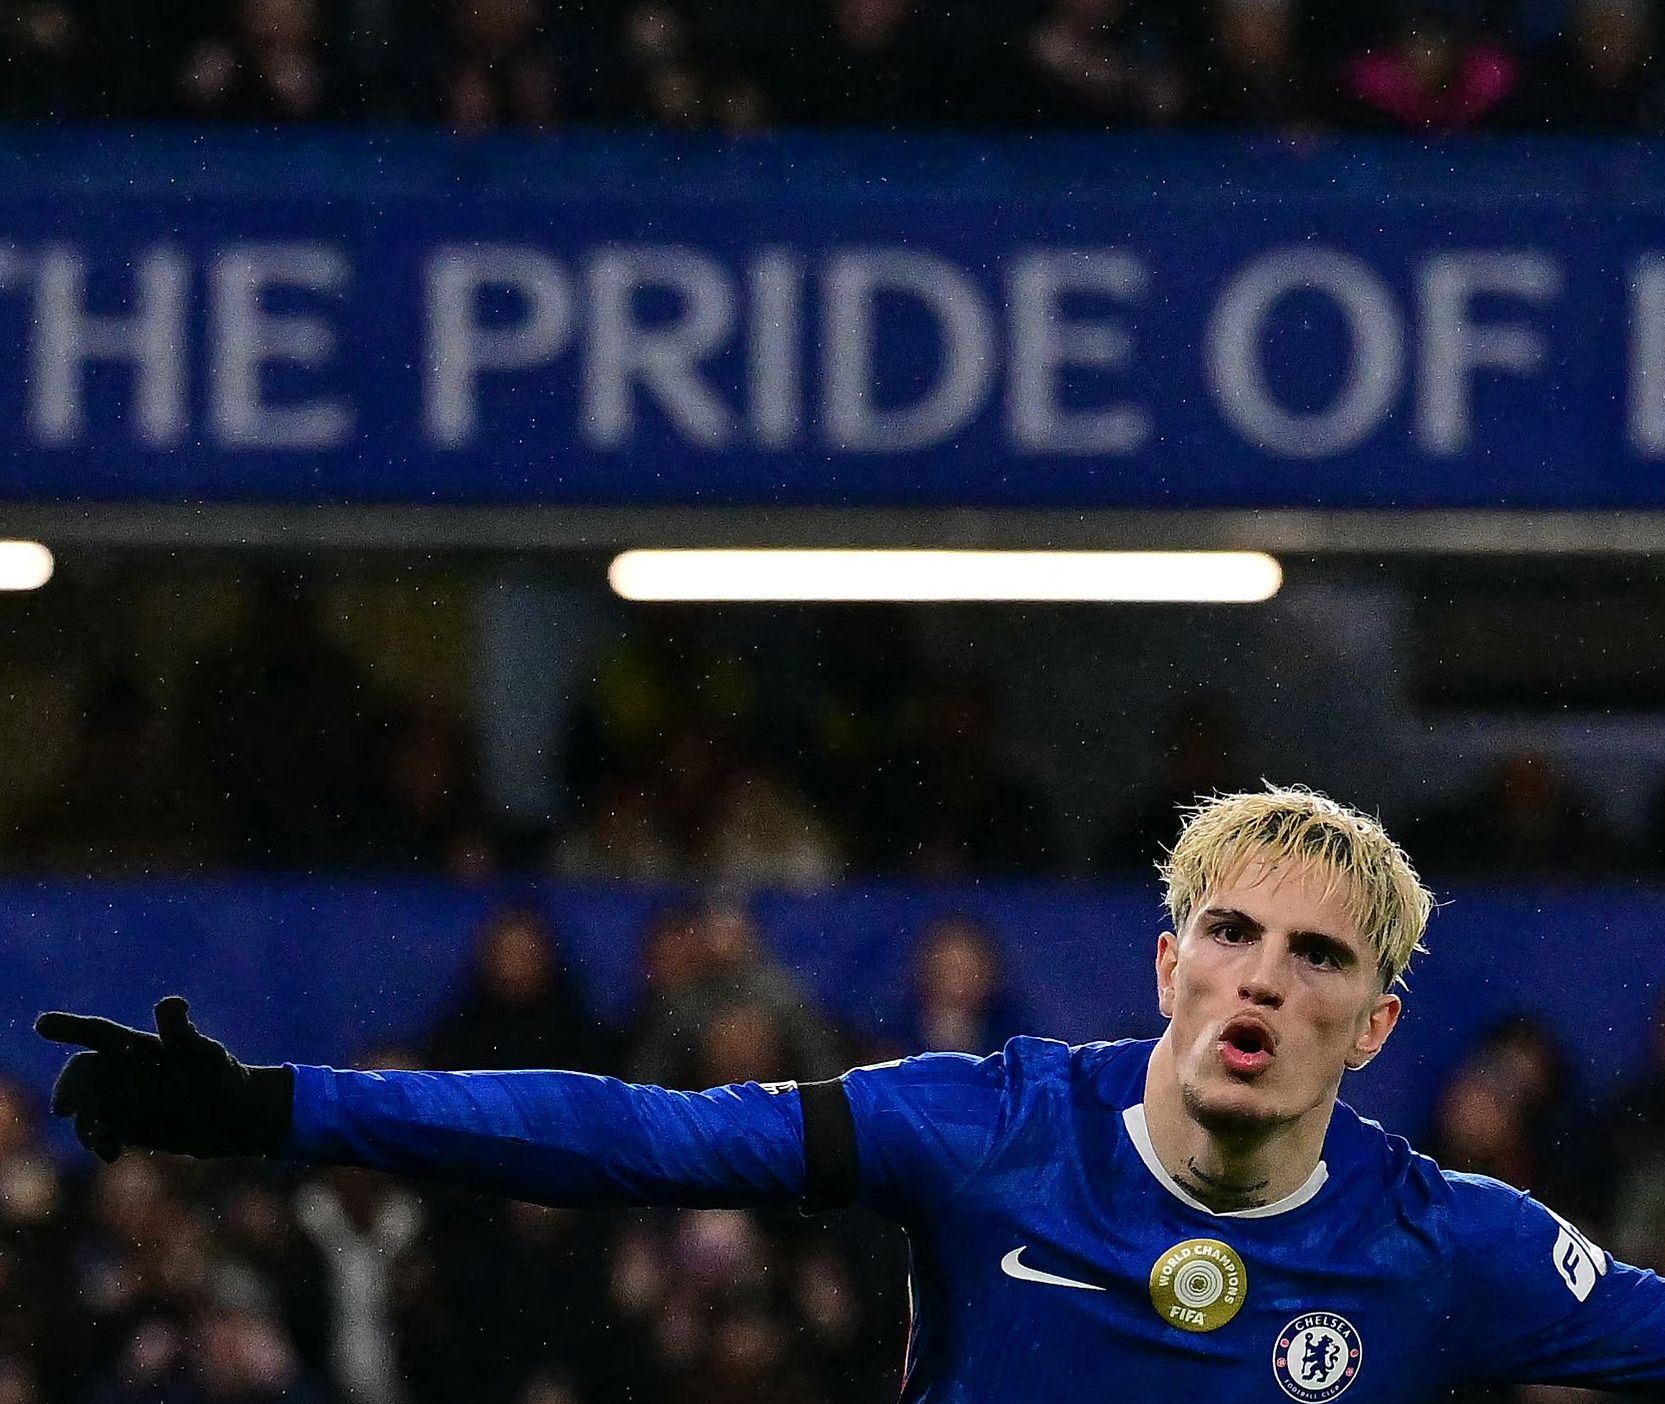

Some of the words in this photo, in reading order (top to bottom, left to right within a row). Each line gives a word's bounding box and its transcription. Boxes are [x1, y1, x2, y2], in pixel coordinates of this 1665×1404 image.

[420, 241, 1154, 458] PRIDE
[1203, 244, 1559, 462] OF
[1158, 1245, 1192, 1287] WORLD
[1193, 1244, 1239, 1305] CHAMPIONS
[1170, 1305, 1205, 1325] FIFA
[1294, 1316, 1351, 1338] CHELSEA
